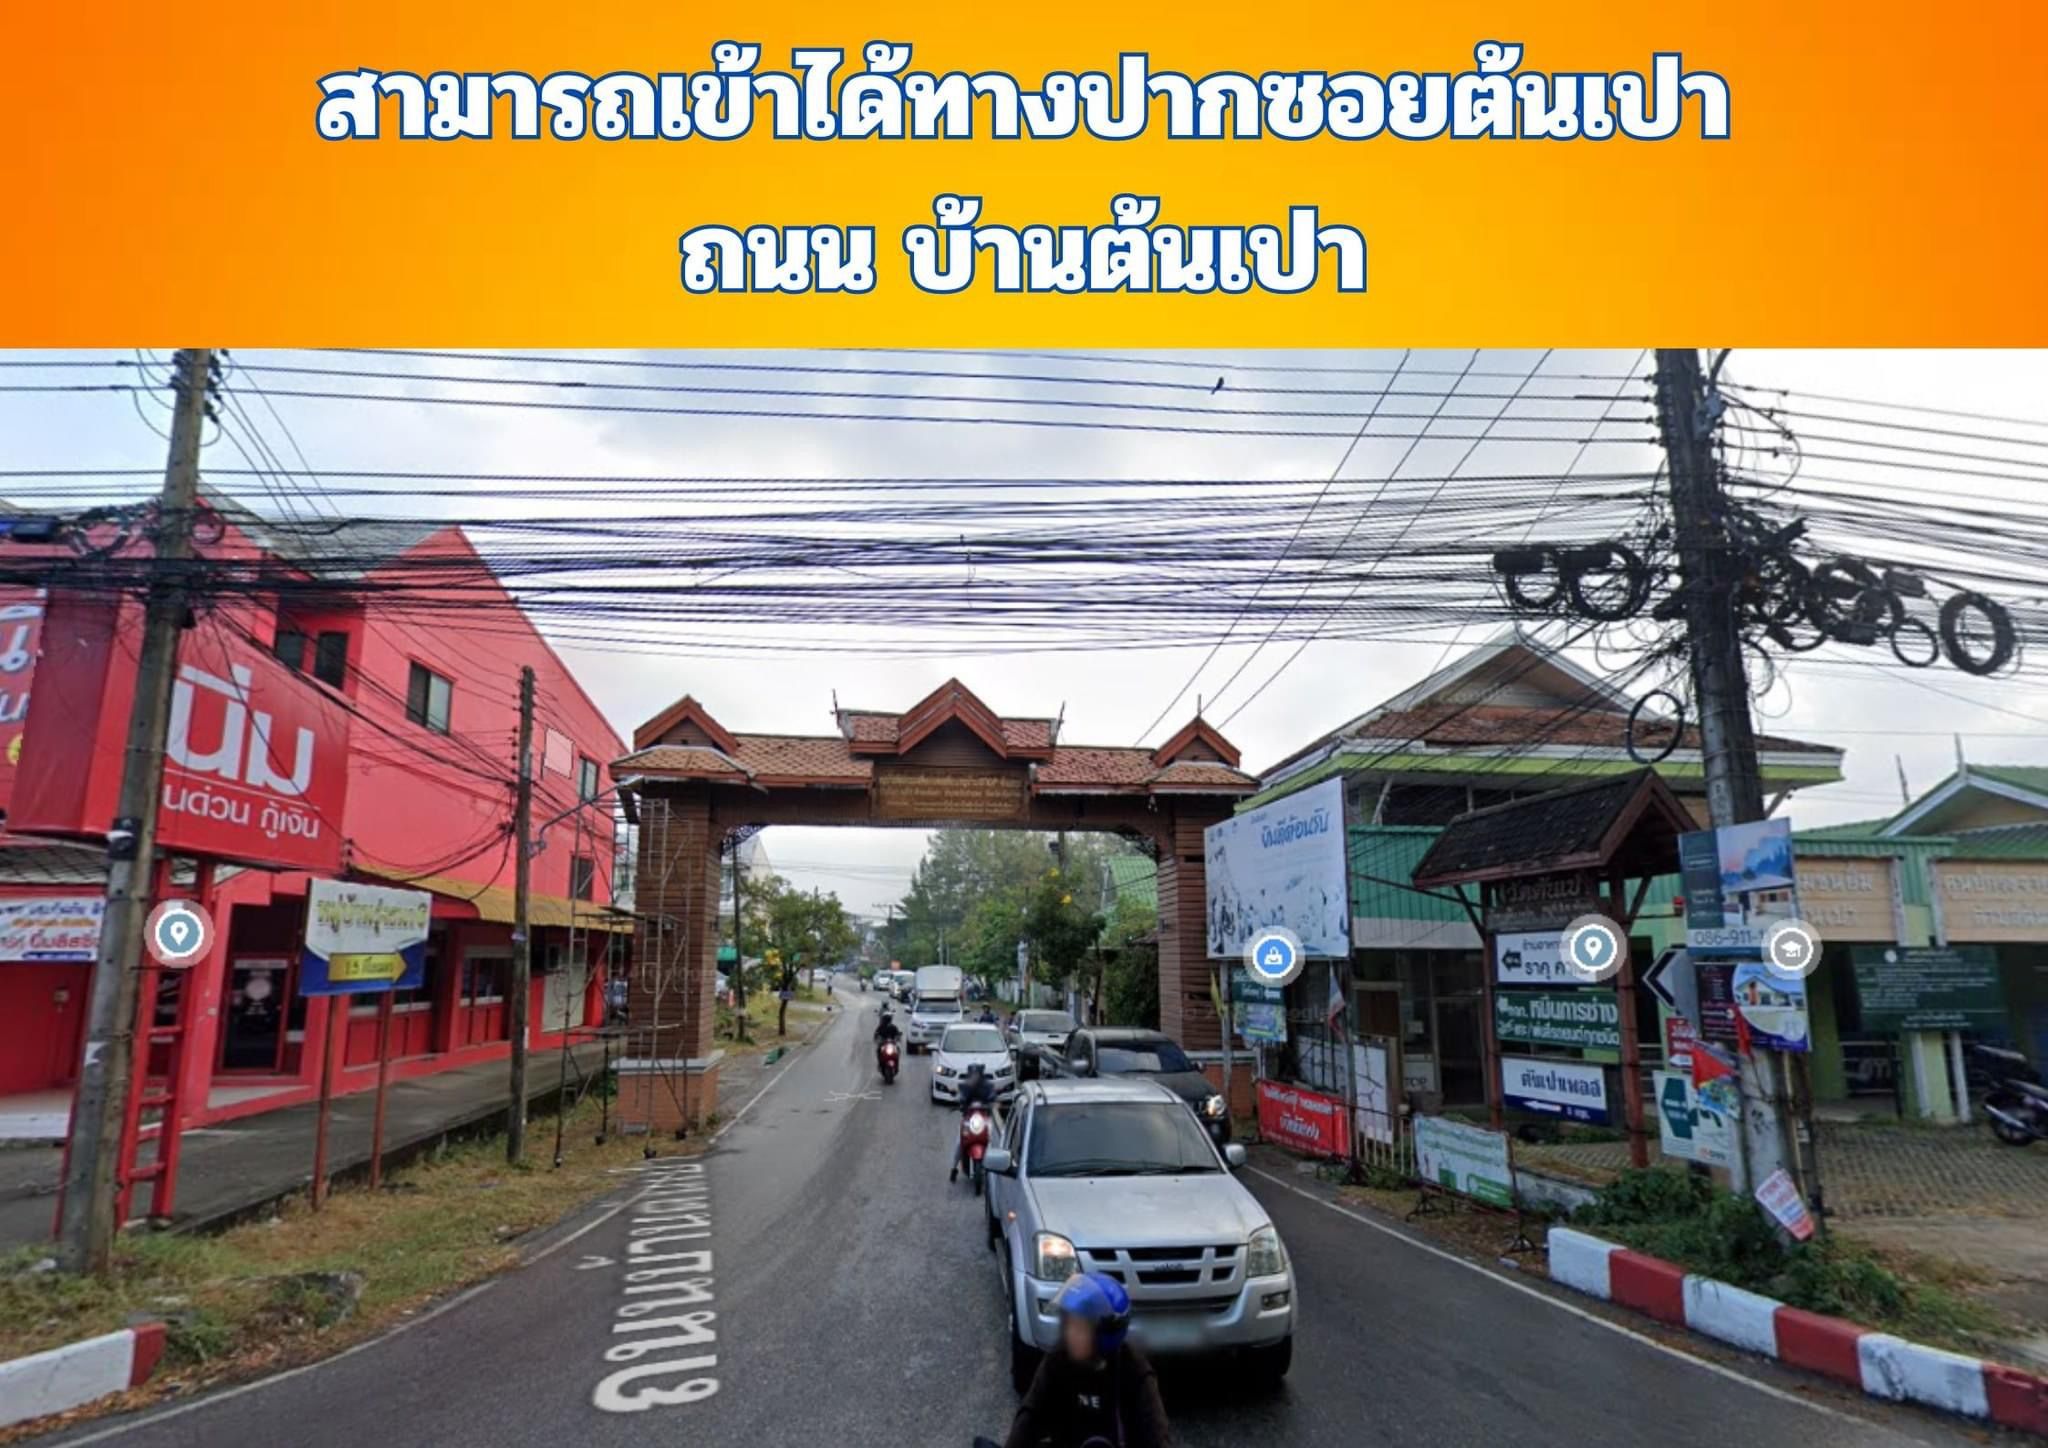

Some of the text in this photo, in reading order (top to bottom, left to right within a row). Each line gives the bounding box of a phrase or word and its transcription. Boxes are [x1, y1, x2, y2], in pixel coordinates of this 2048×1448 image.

[162, 783, 320, 839] นด่วน กู้เงิน
